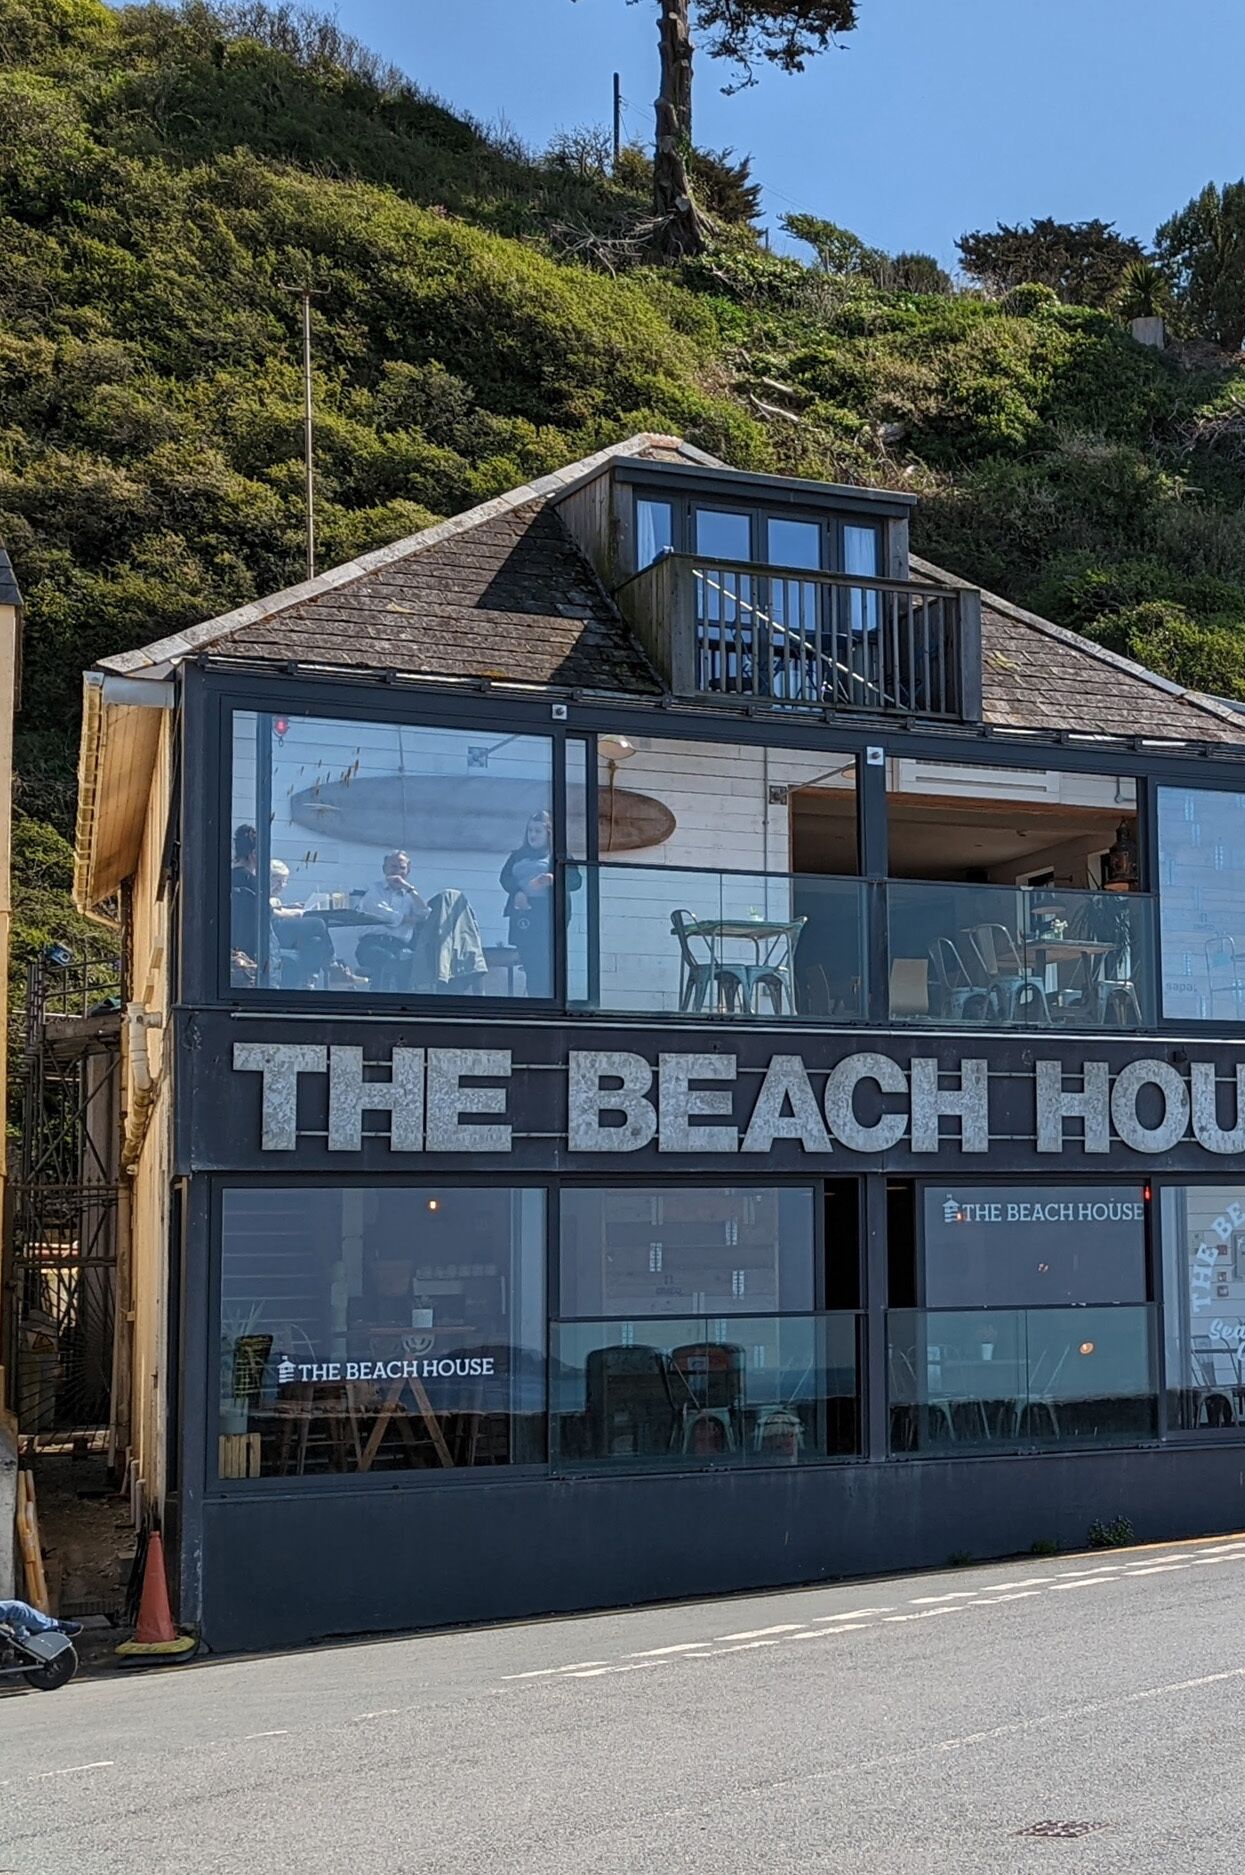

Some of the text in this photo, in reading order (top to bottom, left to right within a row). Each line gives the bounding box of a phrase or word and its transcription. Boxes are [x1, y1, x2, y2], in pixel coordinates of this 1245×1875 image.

[231, 1042, 513, 1153] THE
[566, 1049, 989, 1154] BEACH
[962, 1203, 1145, 1222] THE BEACH HOUSE
[1191, 1242, 1219, 1313] THE
[298, 1357, 495, 1382] THE BEACH HOUSE
